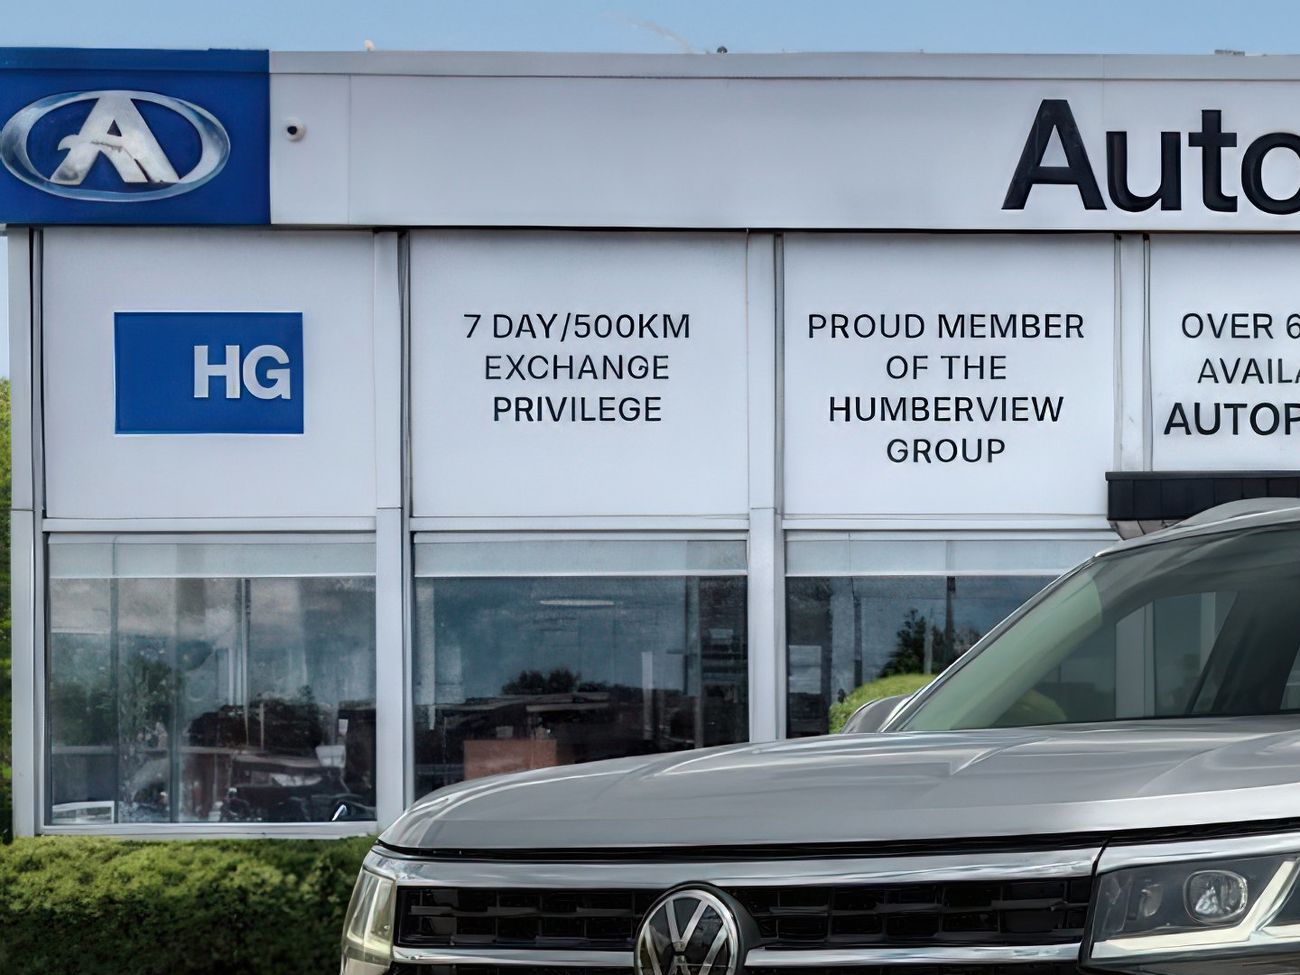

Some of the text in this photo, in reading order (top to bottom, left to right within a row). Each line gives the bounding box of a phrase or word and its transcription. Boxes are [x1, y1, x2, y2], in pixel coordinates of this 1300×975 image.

[463, 312, 690, 342] 7 DAY/500KM
[807, 313, 1085, 339] PROUD MEMBER
[1181, 313, 1274, 340] OVER
[193, 344, 292, 400] HG
[485, 354, 670, 381] EXCHANGE
[886, 354, 1008, 380] OF THE
[493, 396, 662, 423] PRIVILEGE
[828, 396, 1065, 423] HUMBERVIEW
[886, 438, 1006, 464] GROUP
